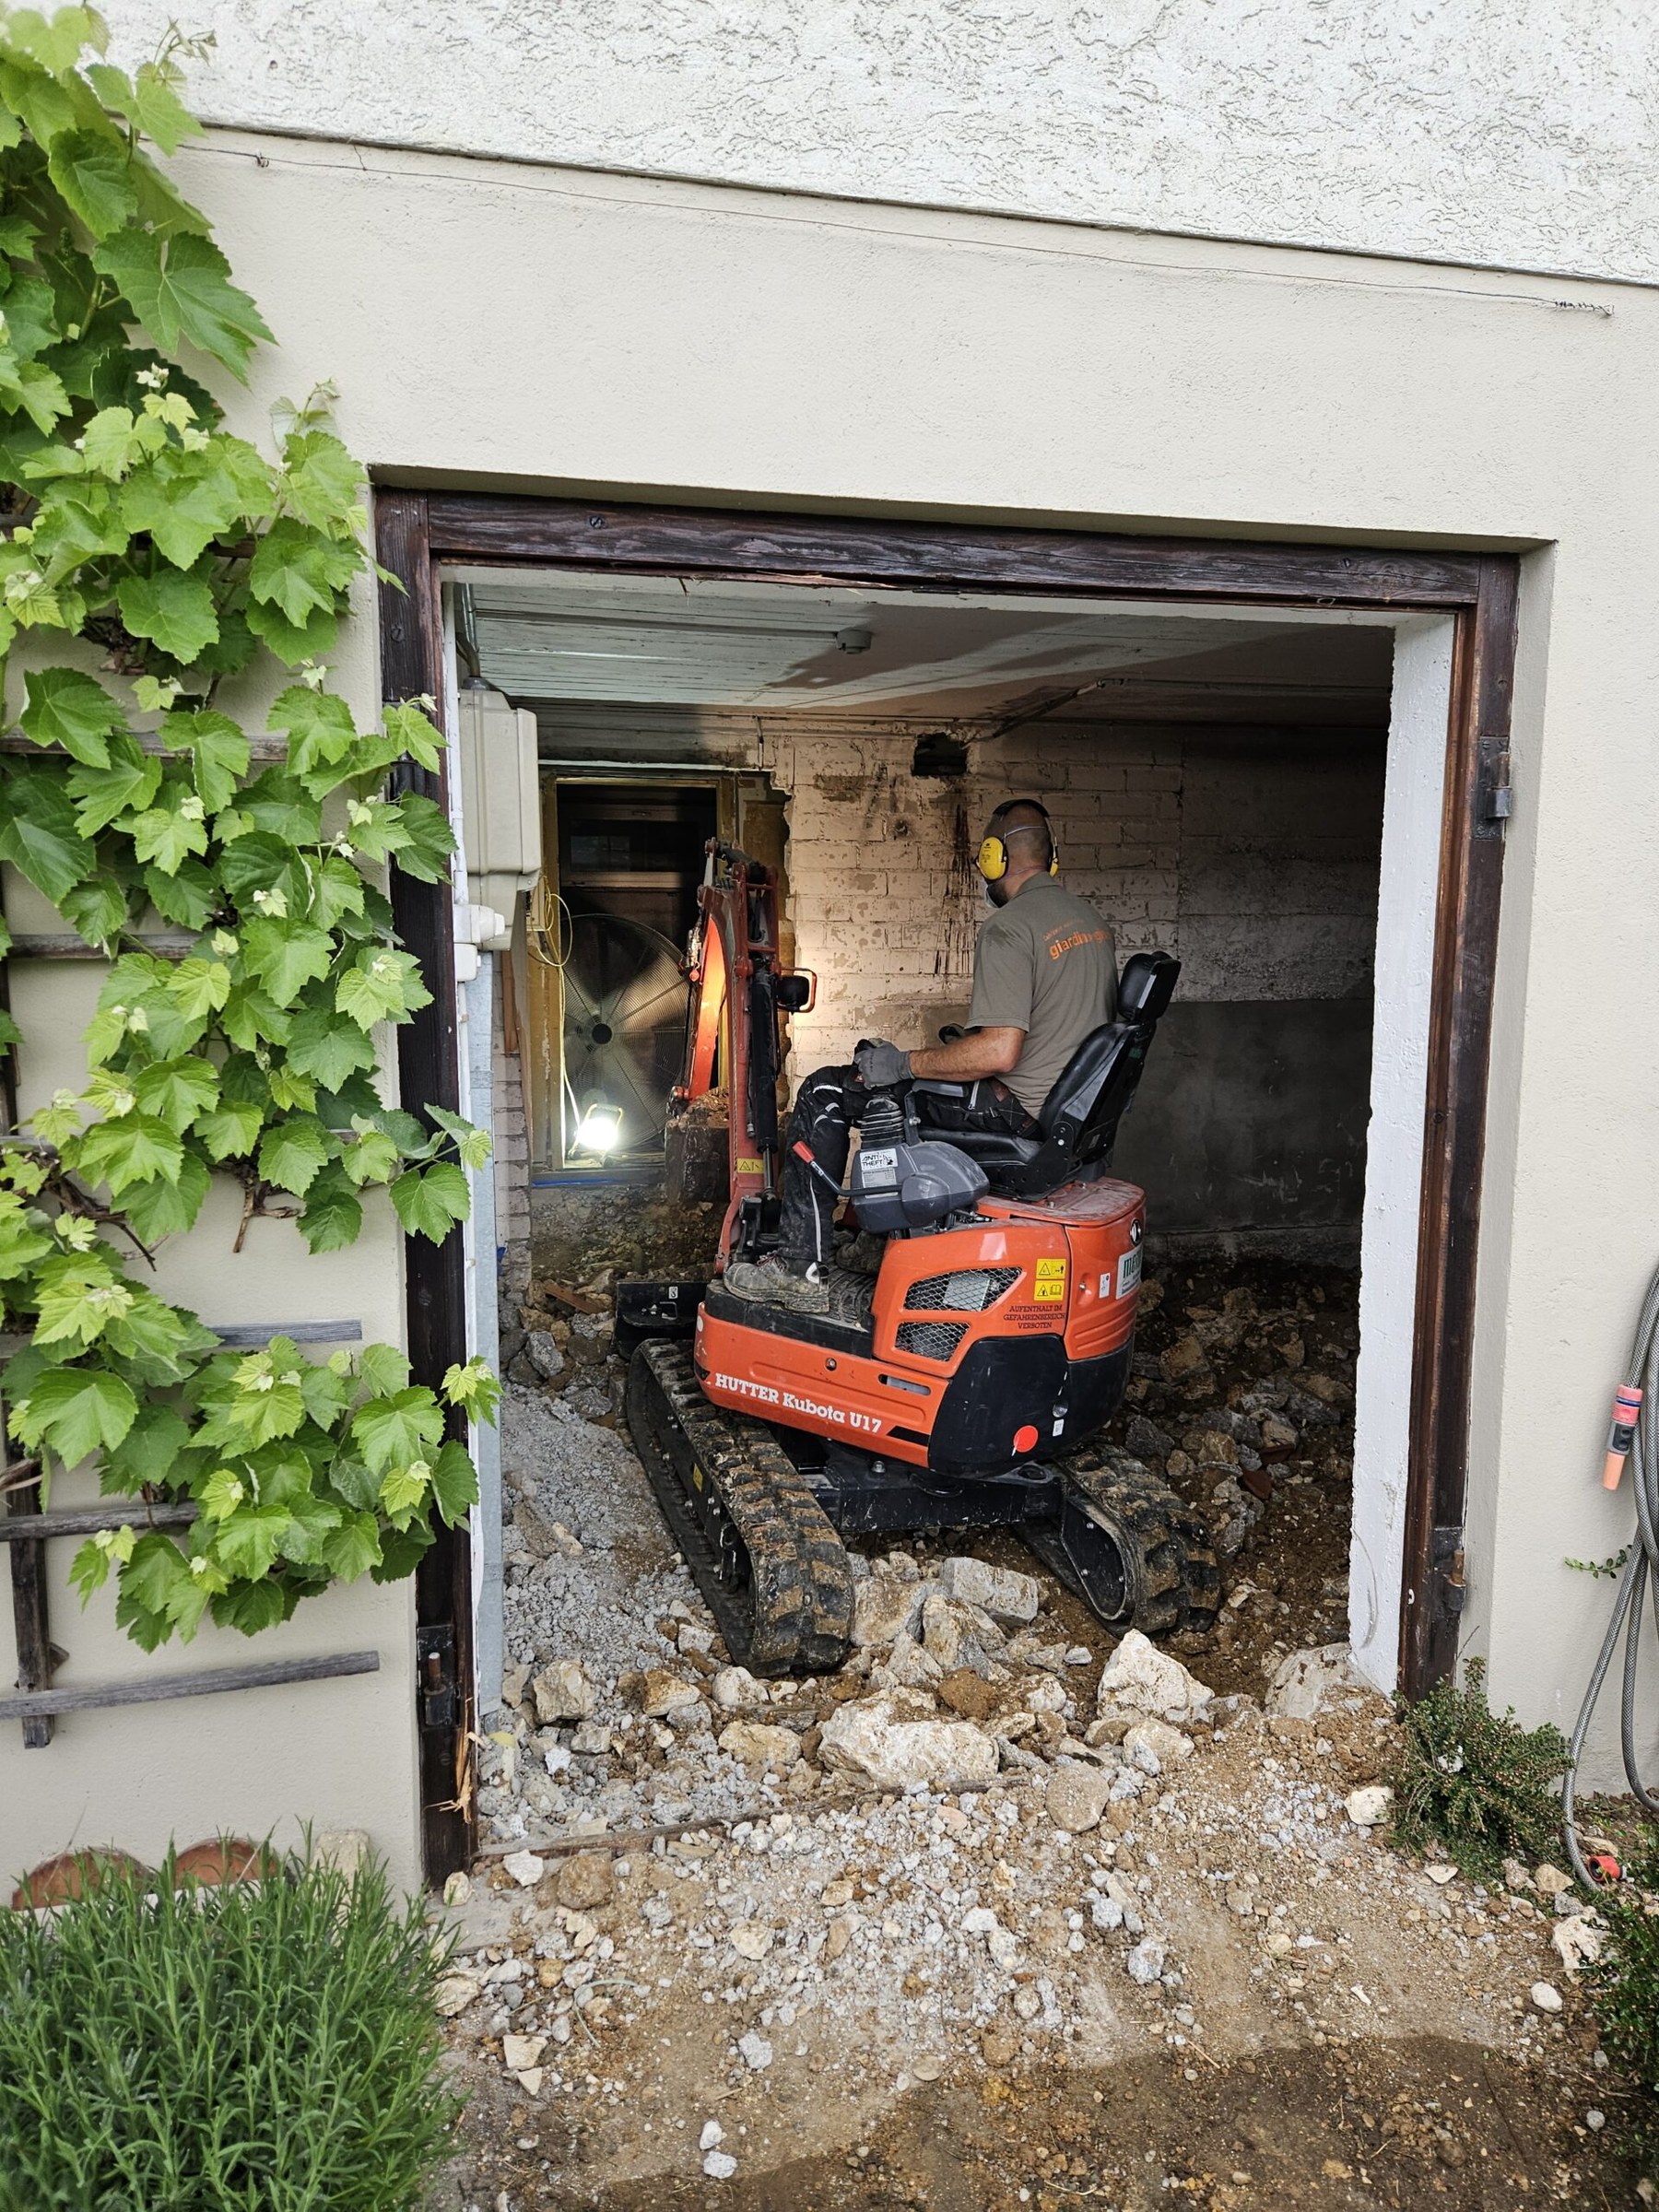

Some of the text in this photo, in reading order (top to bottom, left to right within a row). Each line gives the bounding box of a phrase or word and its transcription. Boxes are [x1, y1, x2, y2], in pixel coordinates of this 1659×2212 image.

[862, 1159, 883, 1167] THEFT
[1009, 1304, 1053, 1312] AUFENTHALT
[715, 1372, 882, 1433] HUTTER Kubota U17
